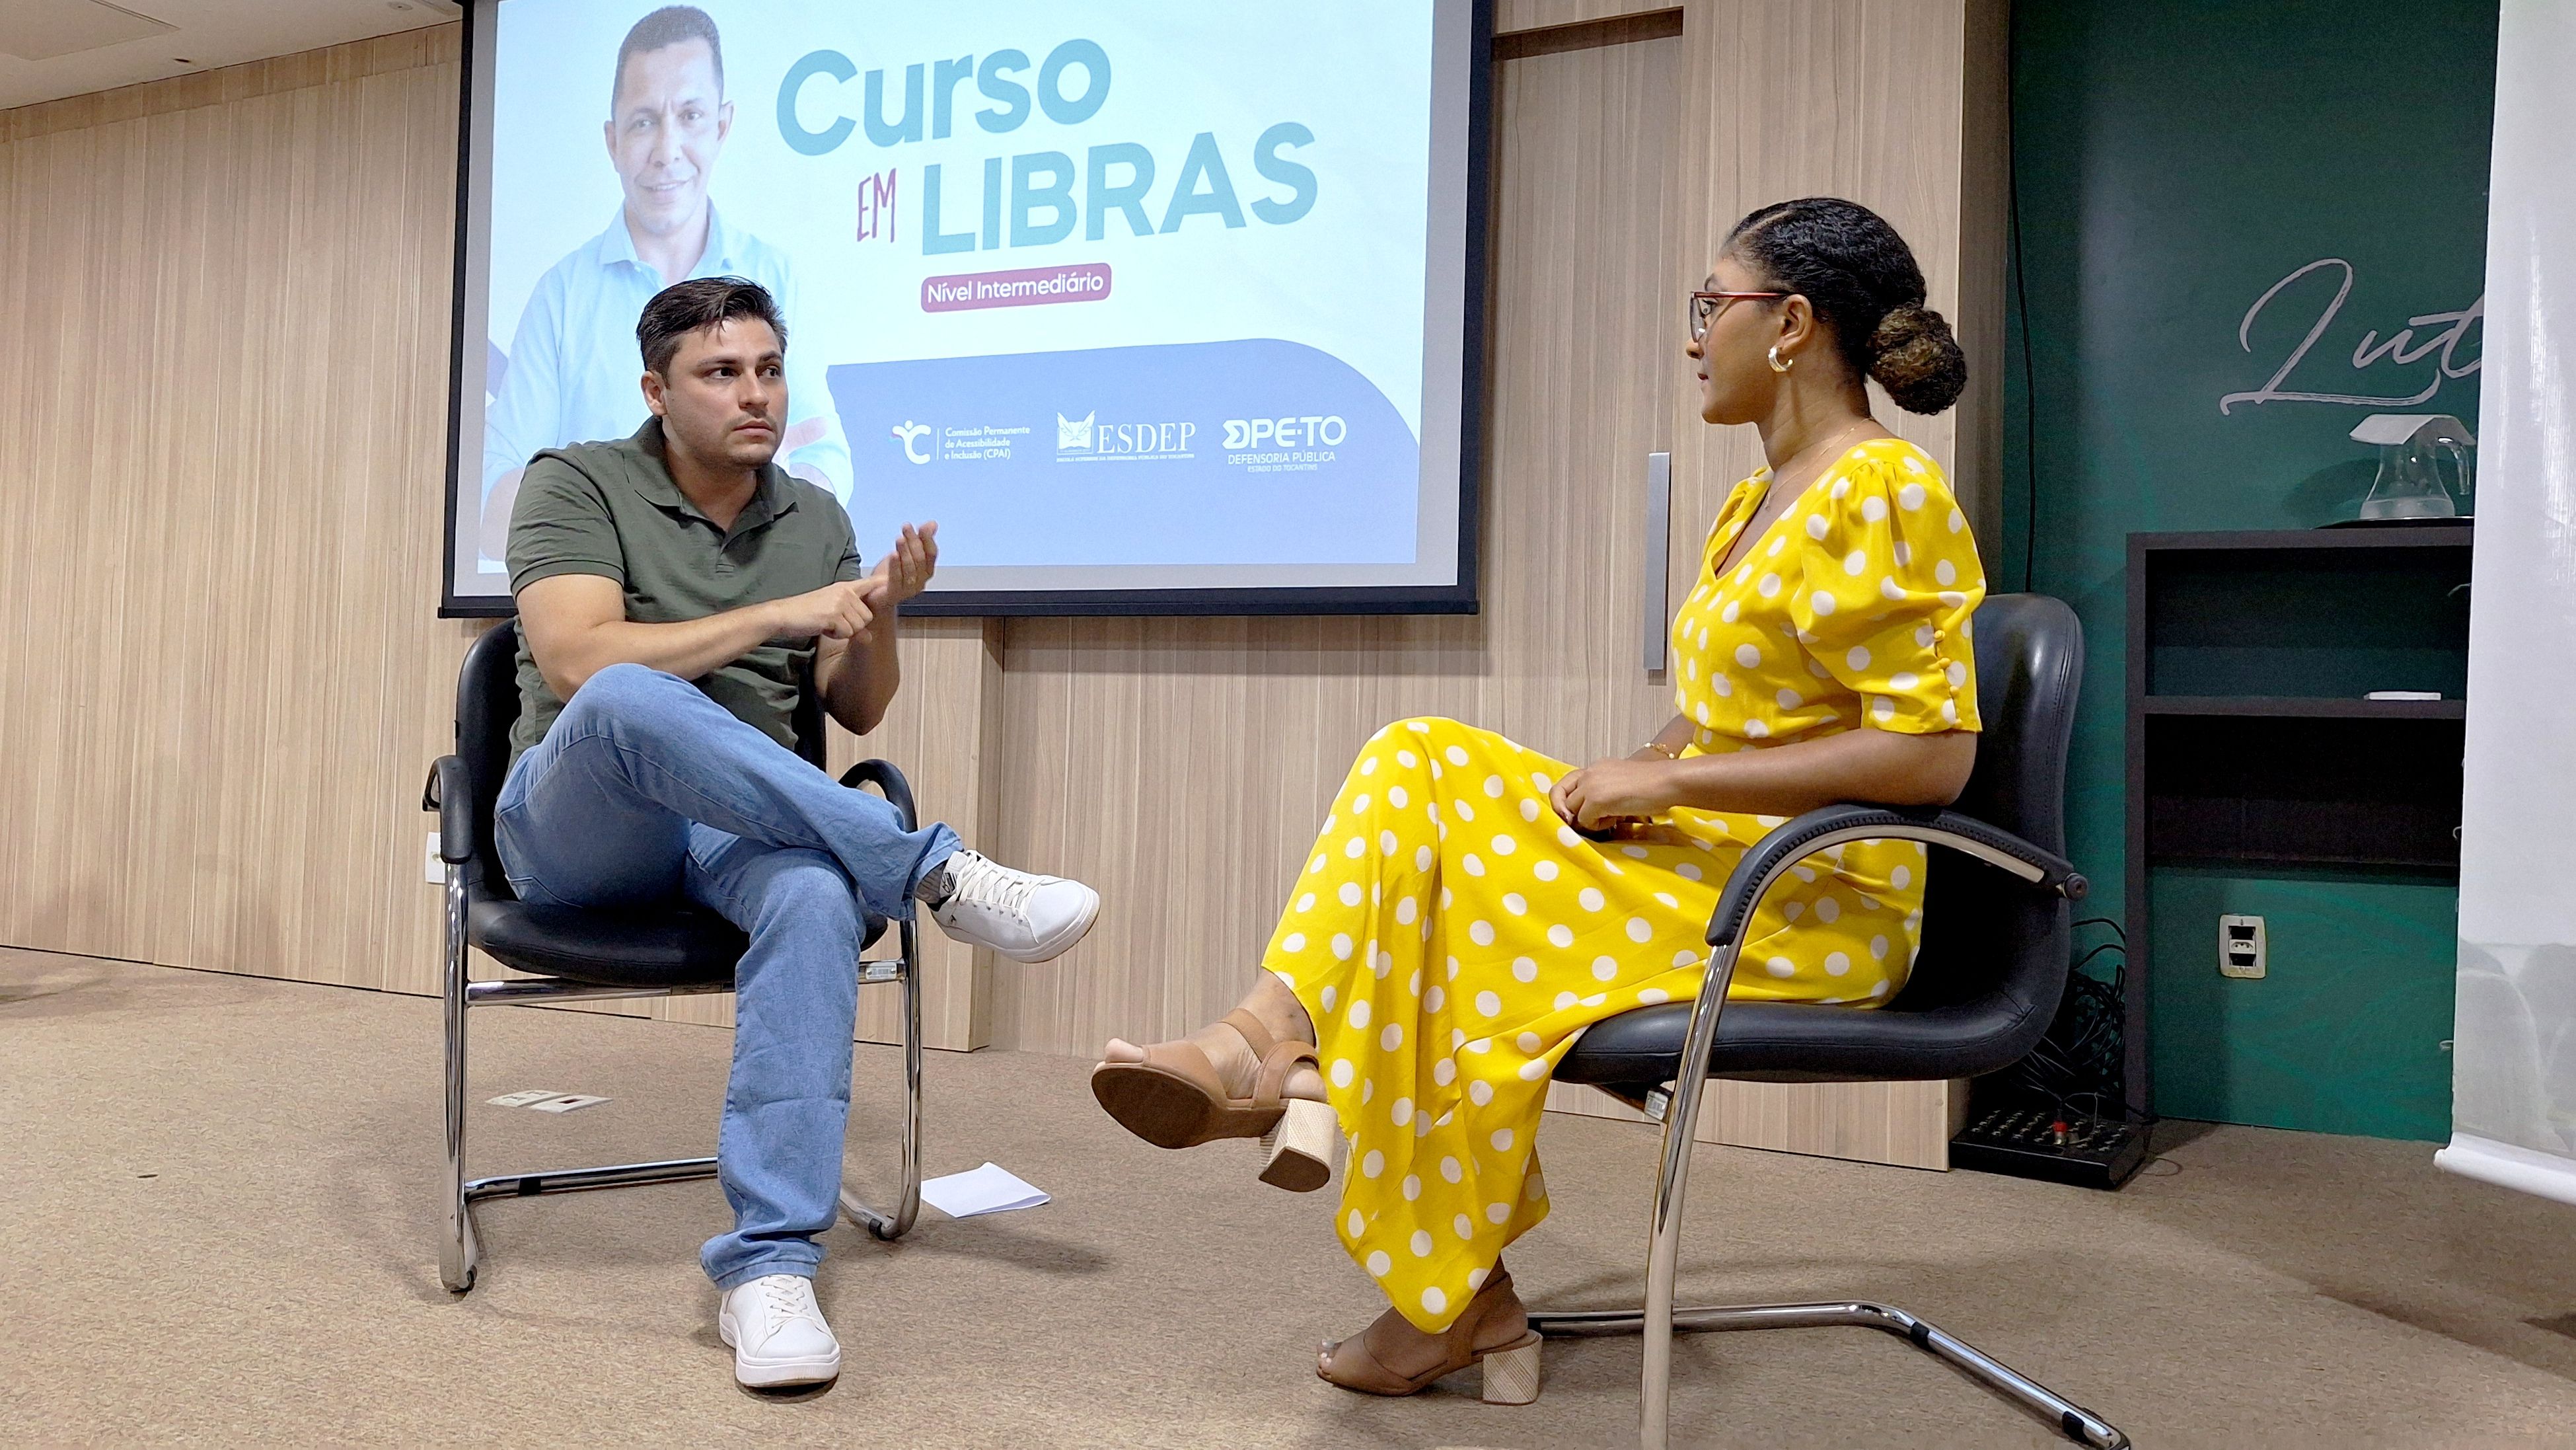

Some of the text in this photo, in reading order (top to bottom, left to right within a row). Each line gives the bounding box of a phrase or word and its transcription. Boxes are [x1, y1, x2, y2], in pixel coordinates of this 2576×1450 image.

[777, 38, 1111, 156] Curso
[856, 122, 1318, 256] EM LIBRAS
[928, 272, 1104, 303] Nível Intermediário
[984, 426, 1030, 435] Permanente
[1097, 422, 1196, 453] ESDEP
[945, 439, 955, 448] de
[983, 448, 1011, 460] (CPAI)
[1228, 449, 1336, 465] DEFENSORIA PÚBLICA
